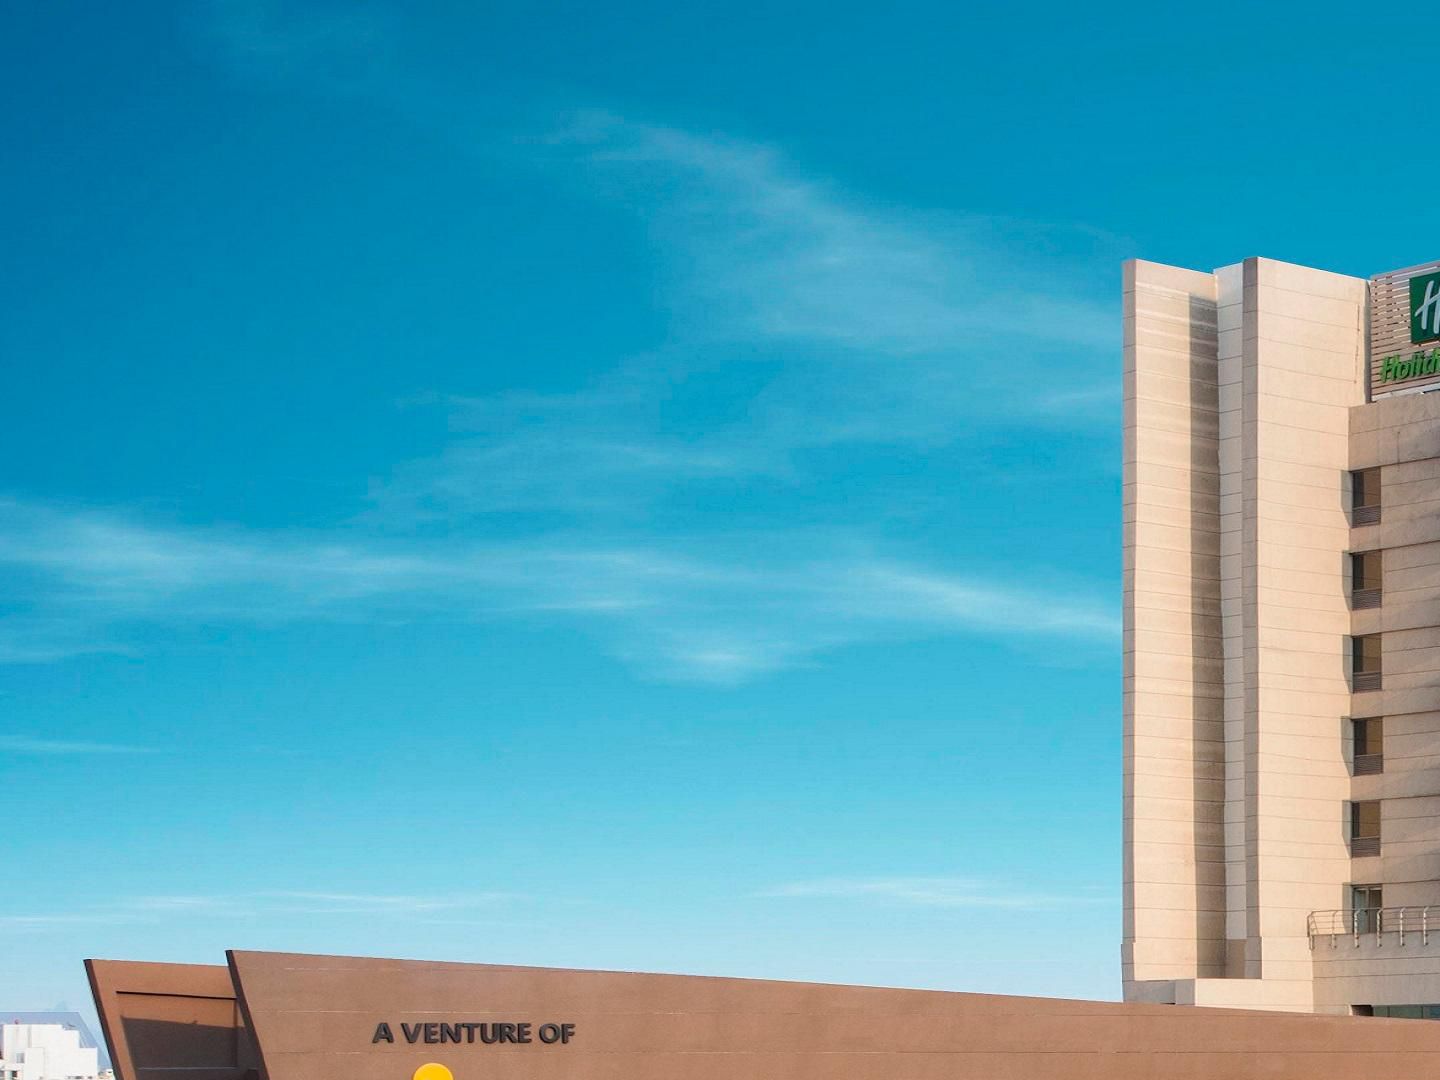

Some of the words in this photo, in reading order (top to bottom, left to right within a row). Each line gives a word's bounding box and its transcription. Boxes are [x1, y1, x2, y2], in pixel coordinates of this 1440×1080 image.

[373, 1023, 394, 1043] A
[401, 1023, 532, 1043] VENTURE
[539, 1023, 575, 1044] OF
